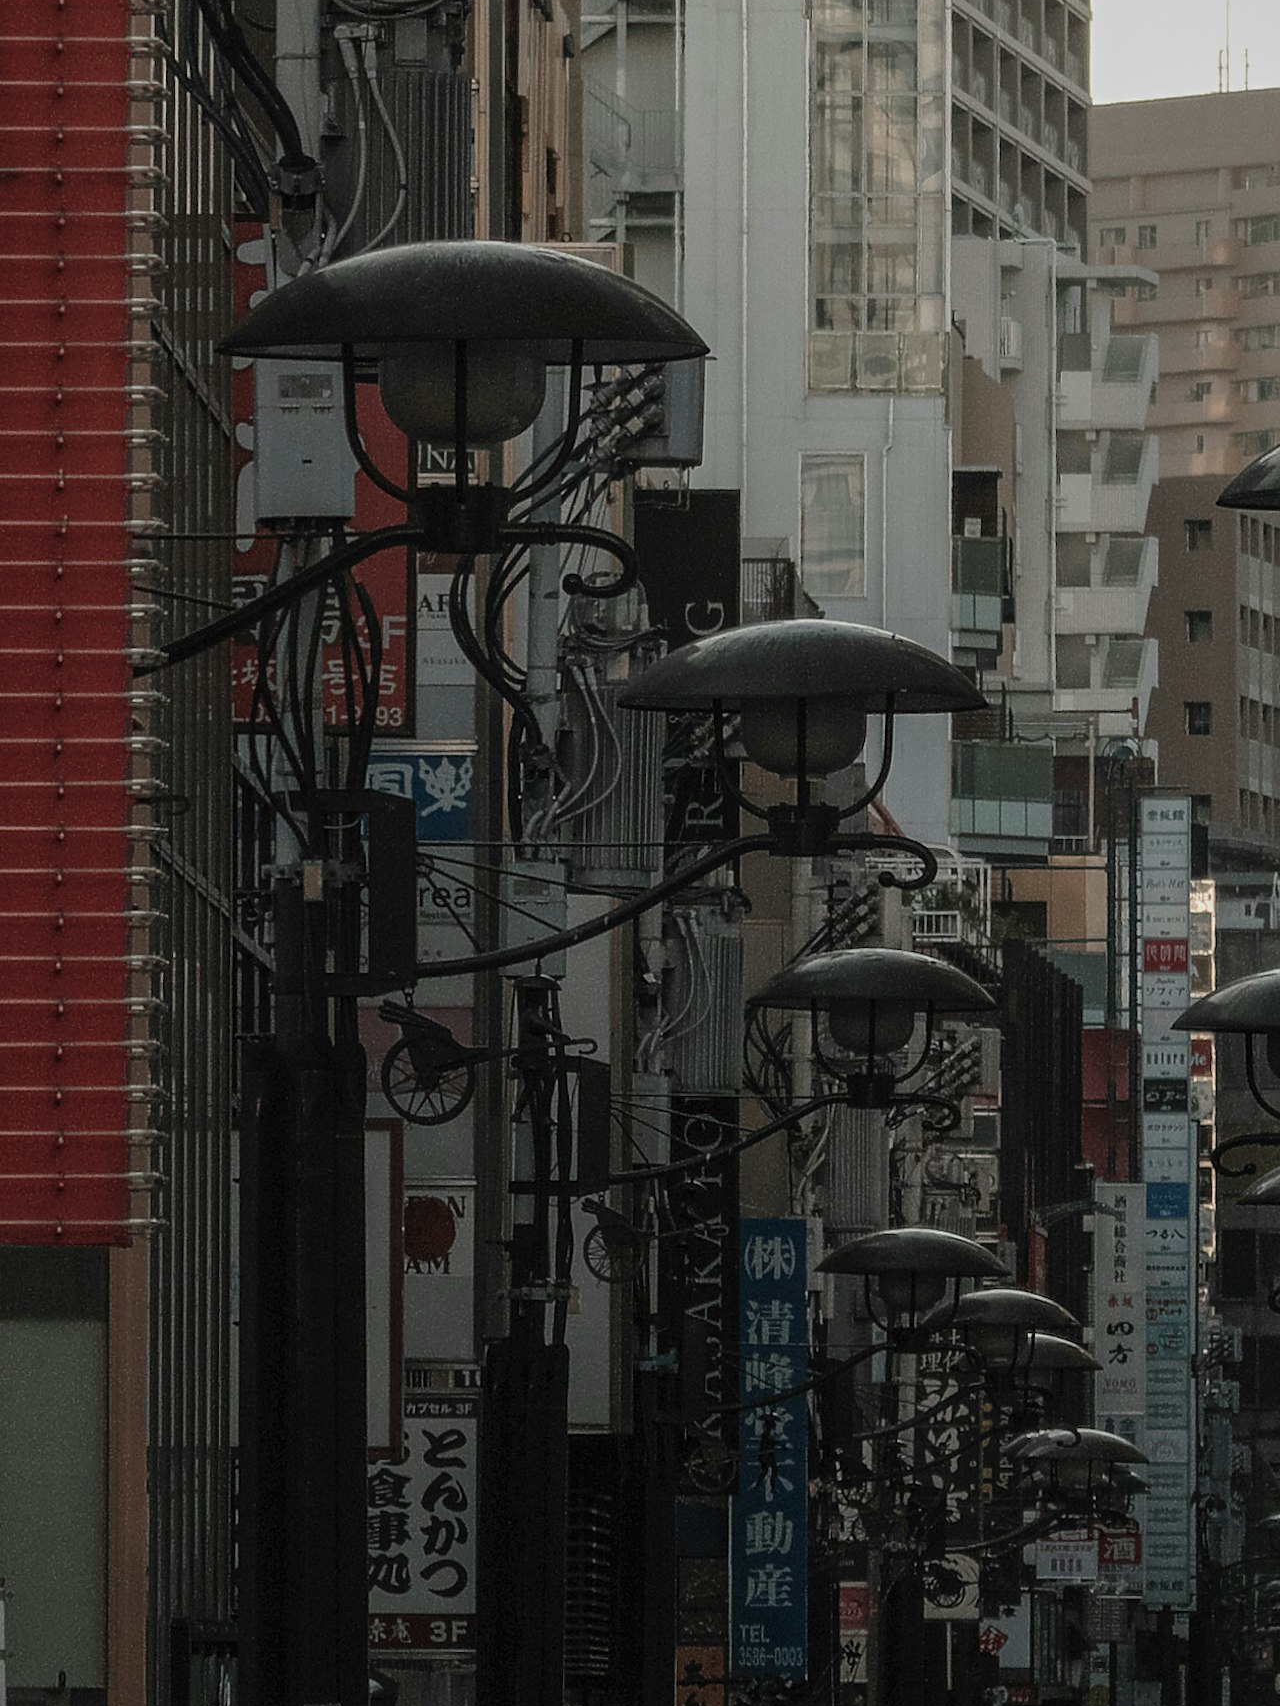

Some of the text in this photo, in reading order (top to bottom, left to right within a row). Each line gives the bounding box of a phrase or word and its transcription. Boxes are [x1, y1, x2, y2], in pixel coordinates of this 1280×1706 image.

[455, 1402, 474, 1415] 3F
[420, 1428, 468, 1598] とんかつ
[429, 1620, 468, 1643] 3F
[738, 1623, 771, 1644] TEL
